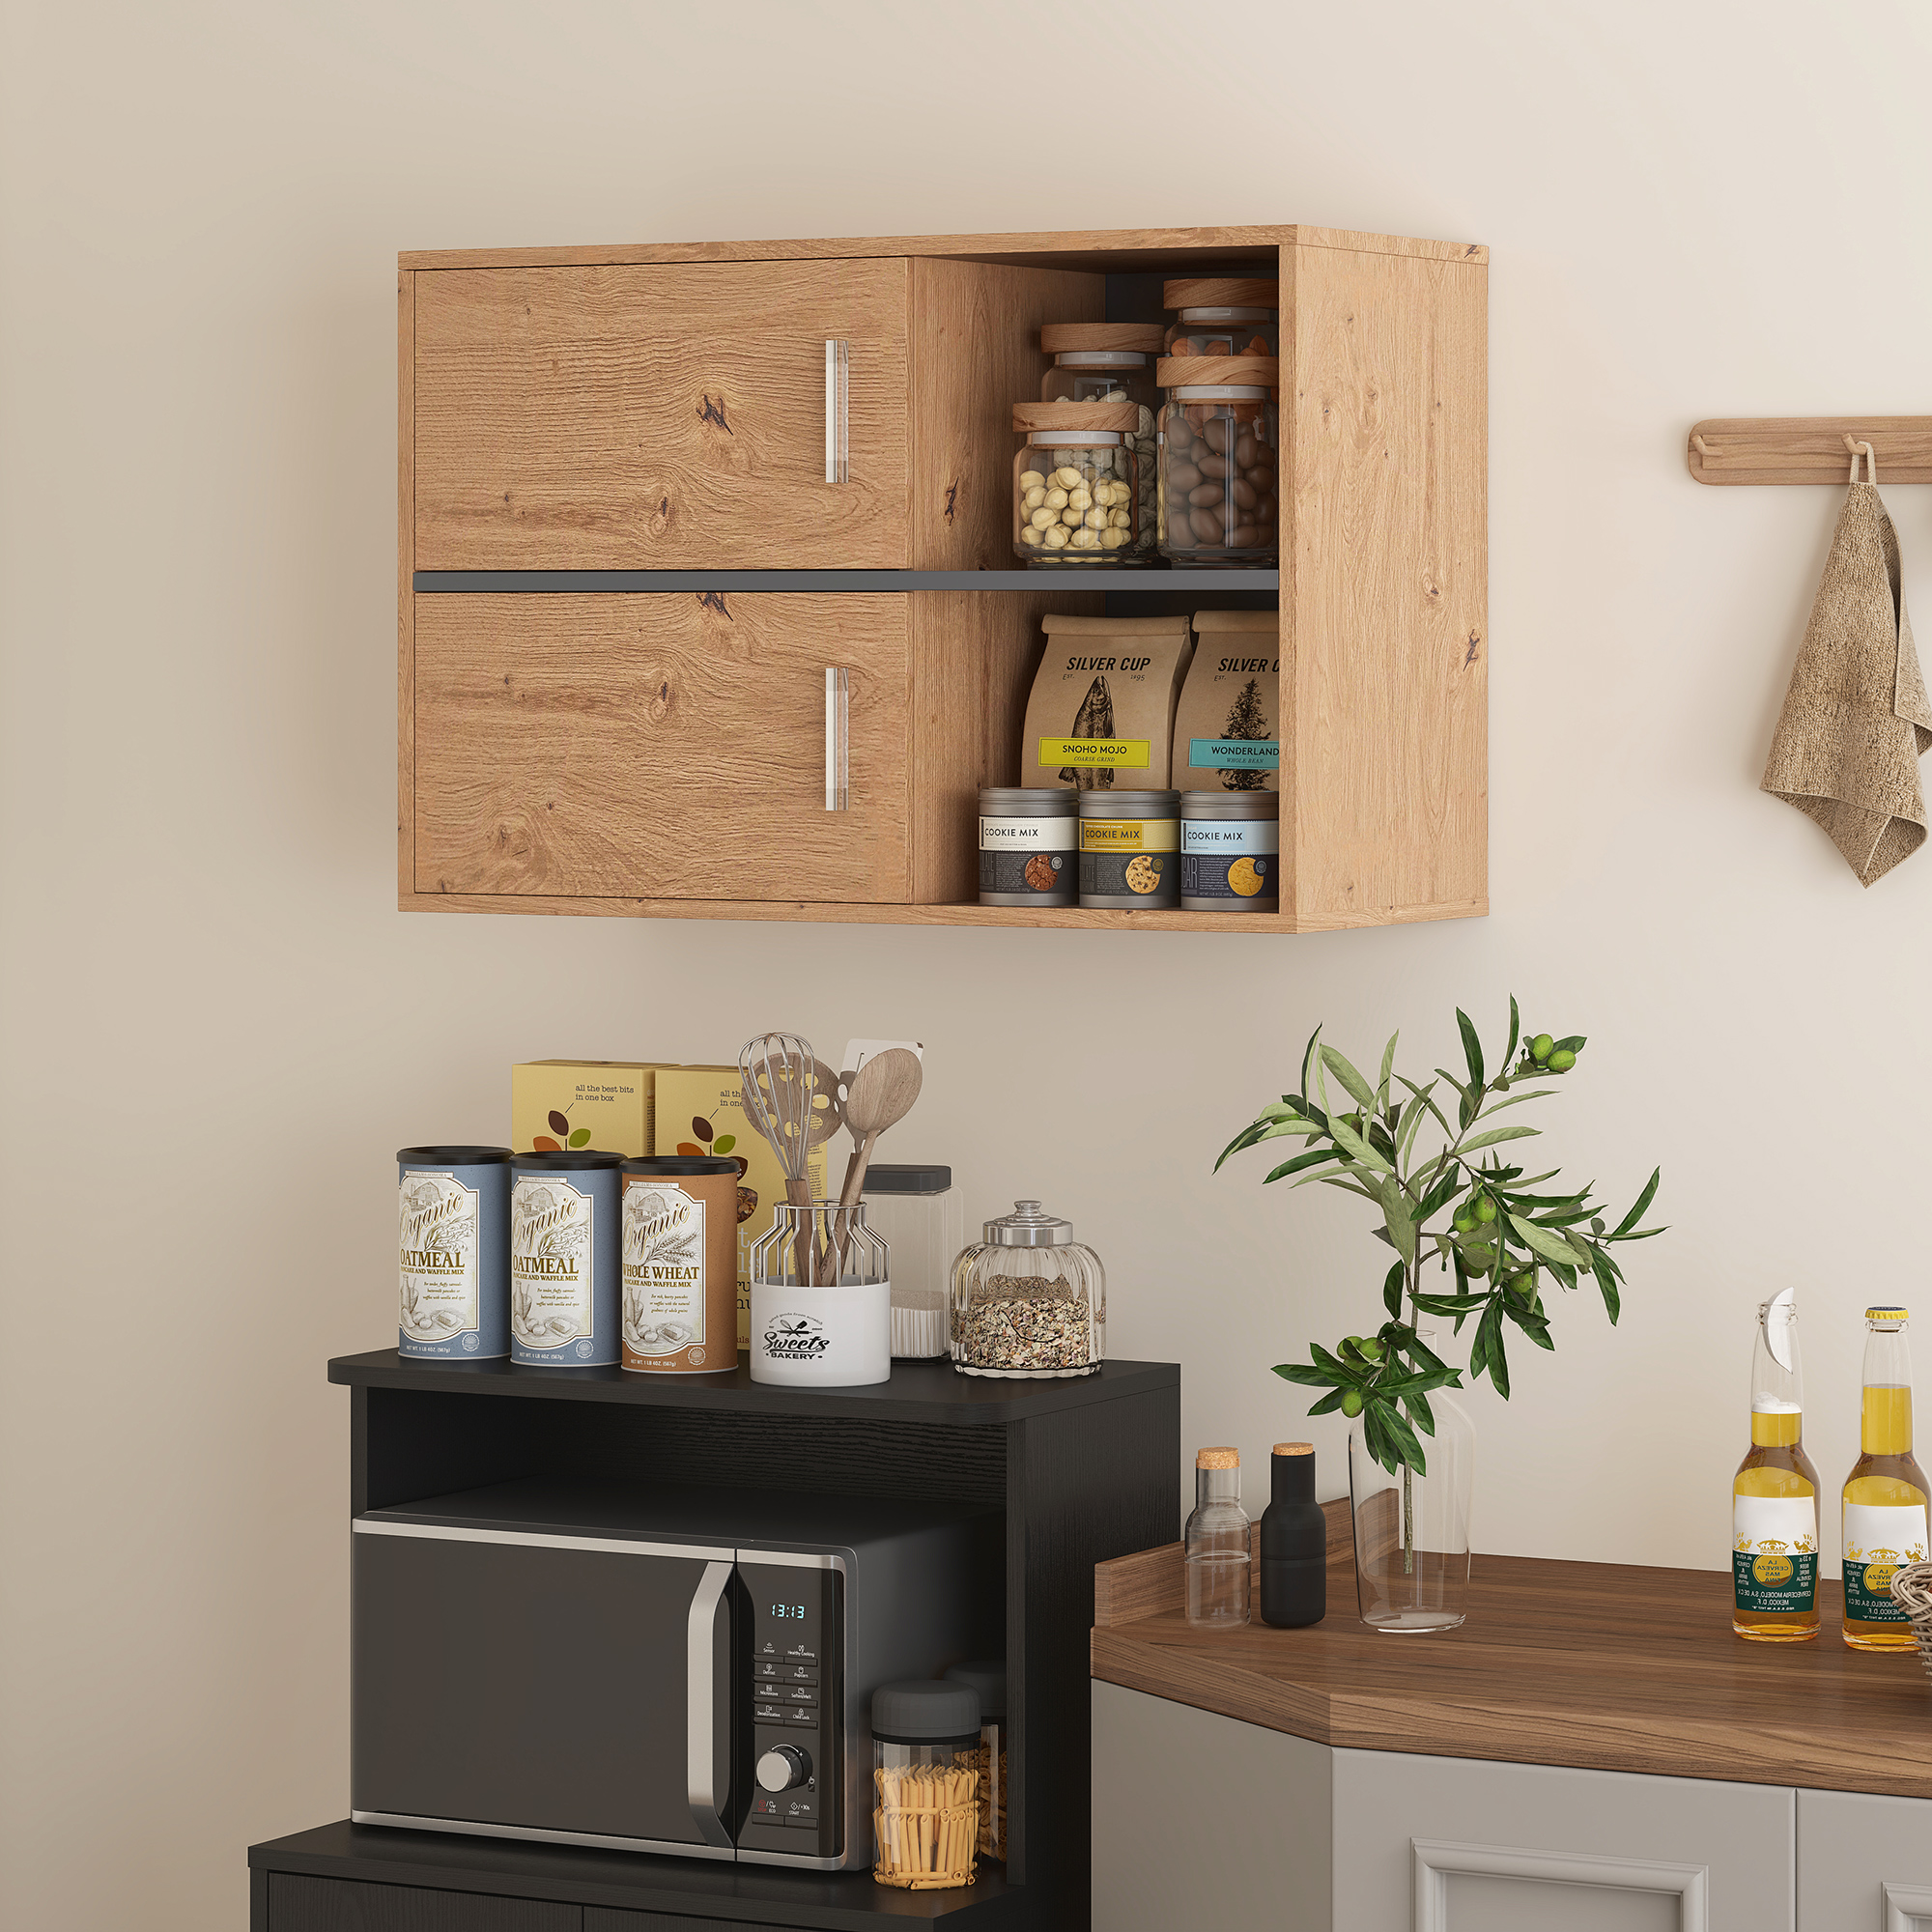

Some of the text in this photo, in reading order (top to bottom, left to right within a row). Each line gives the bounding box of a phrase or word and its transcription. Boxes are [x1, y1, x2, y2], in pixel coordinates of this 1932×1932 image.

[1066, 657, 1151, 671] SILVER CUP
[1218, 658, 1268, 672] SILVER
[1063, 745, 1127, 754] SNOHO MOJO
[1211, 746, 1279, 755] WONDERLAND
[984, 828, 1016, 837] COOKIE
[1085, 830, 1117, 838] COOKIE
[1187, 832, 1243, 840] COOKIE MIX
[400, 1192, 463, 1248] Organic
[513, 1198, 578, 1254] Organic
[623, 1203, 690, 1260] Organic
[400, 1248, 465, 1268] OATMEAL
[513, 1255, 579, 1274] OATMEAL
[652, 1266, 700, 1280] WHEAT
[762, 1331, 831, 1352] Sweets
[772, 1604, 804, 1619] 13:13
